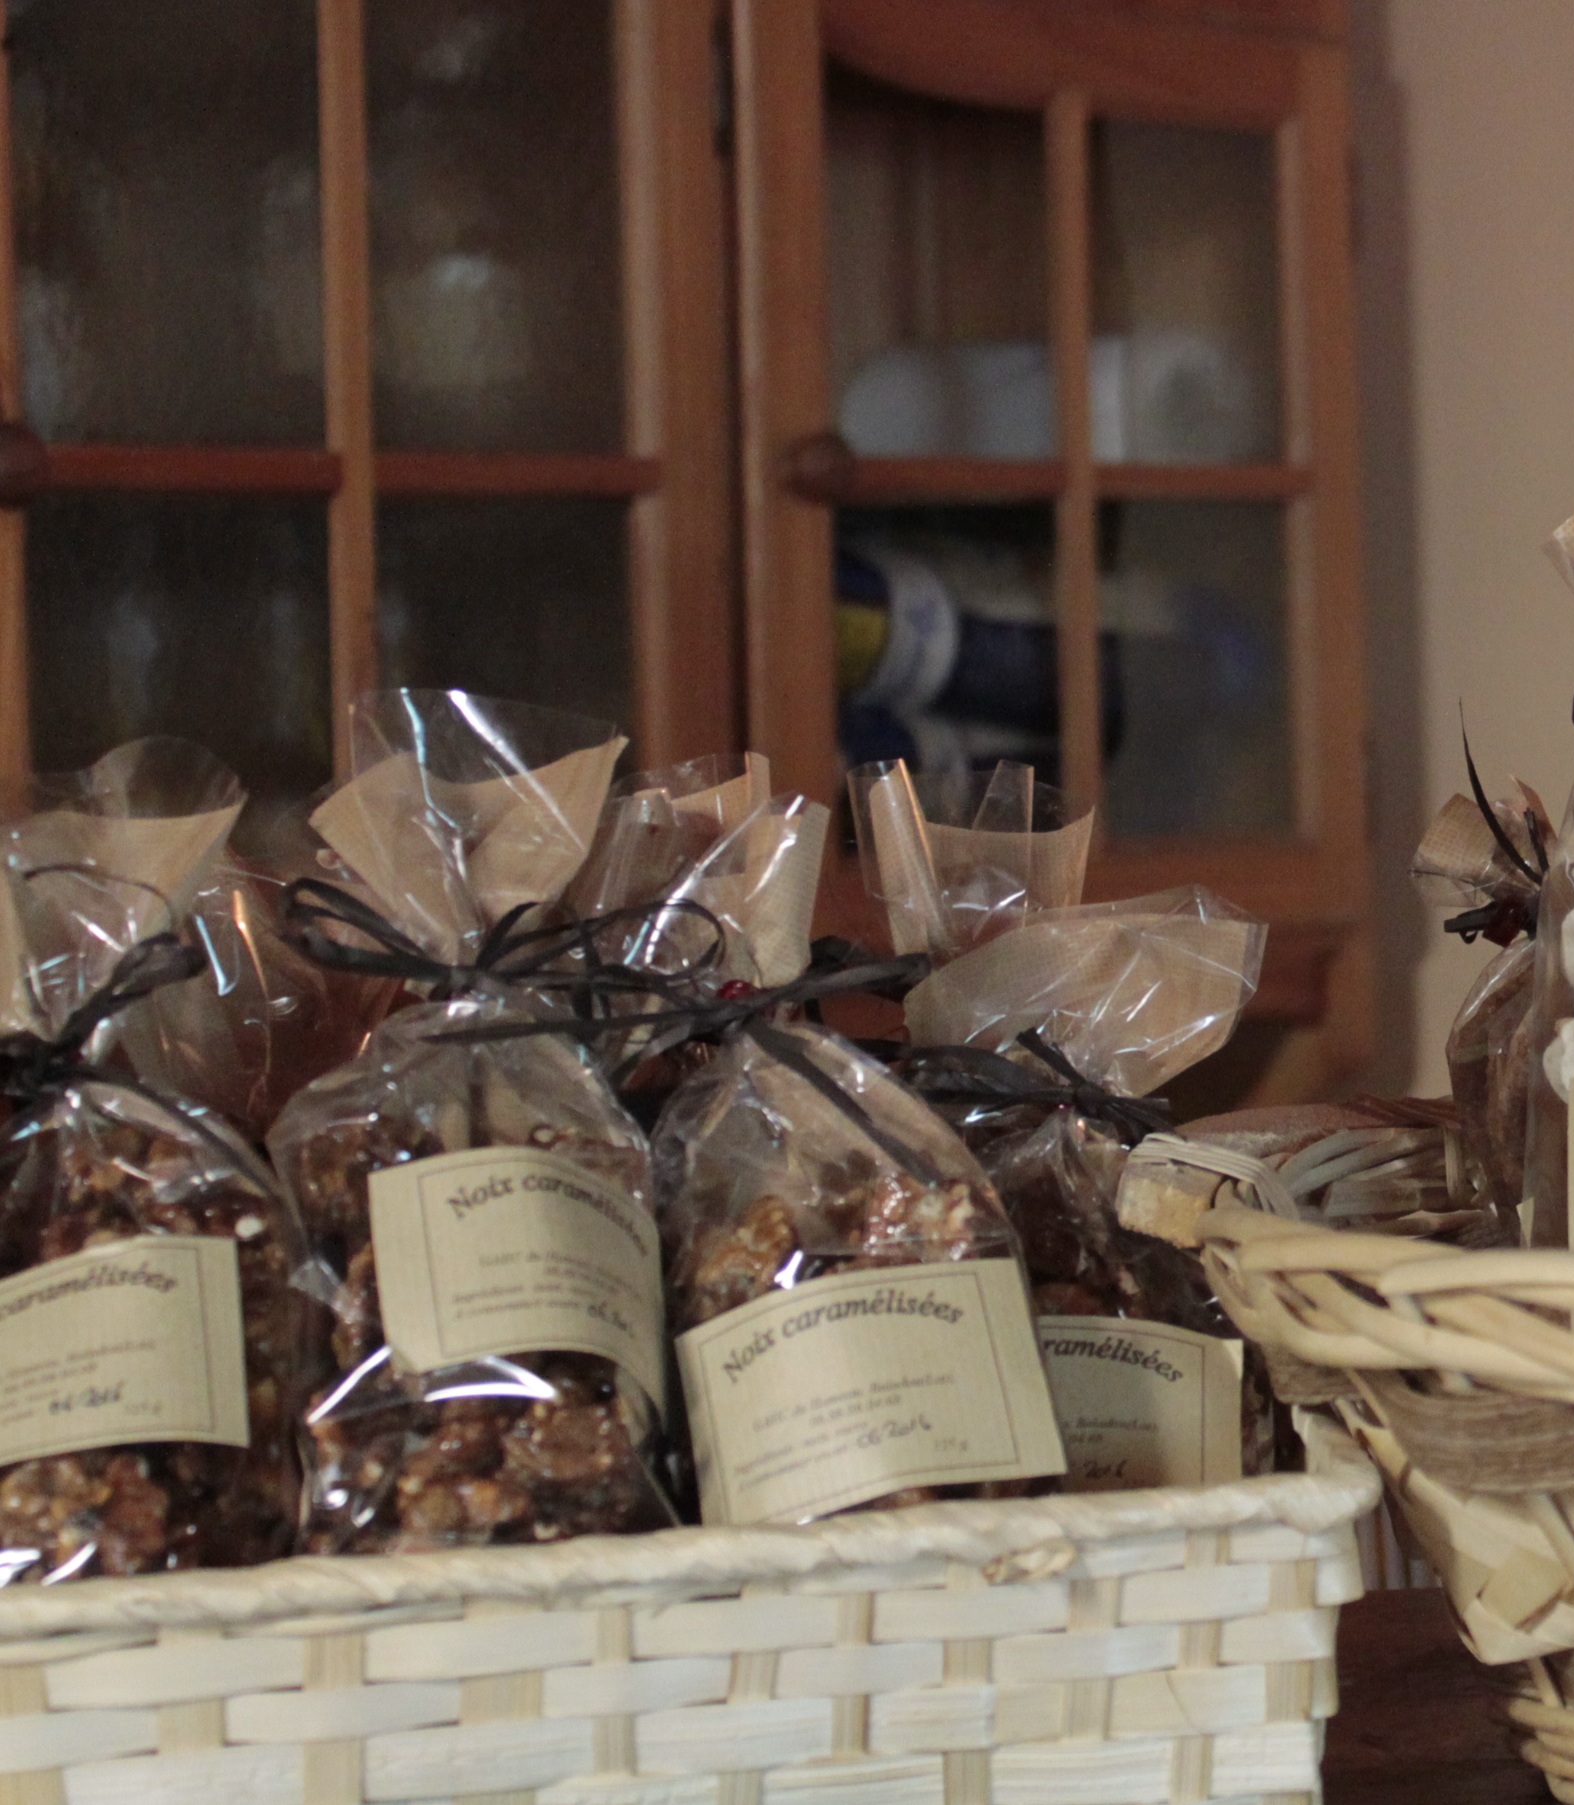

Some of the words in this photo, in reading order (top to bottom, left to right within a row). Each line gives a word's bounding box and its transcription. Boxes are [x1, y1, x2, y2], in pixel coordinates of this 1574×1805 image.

[722, 1328, 777, 1384] Noix
[781, 1288, 964, 1338] caramélisées
[1043, 1337, 1183, 1383] ramélisées
